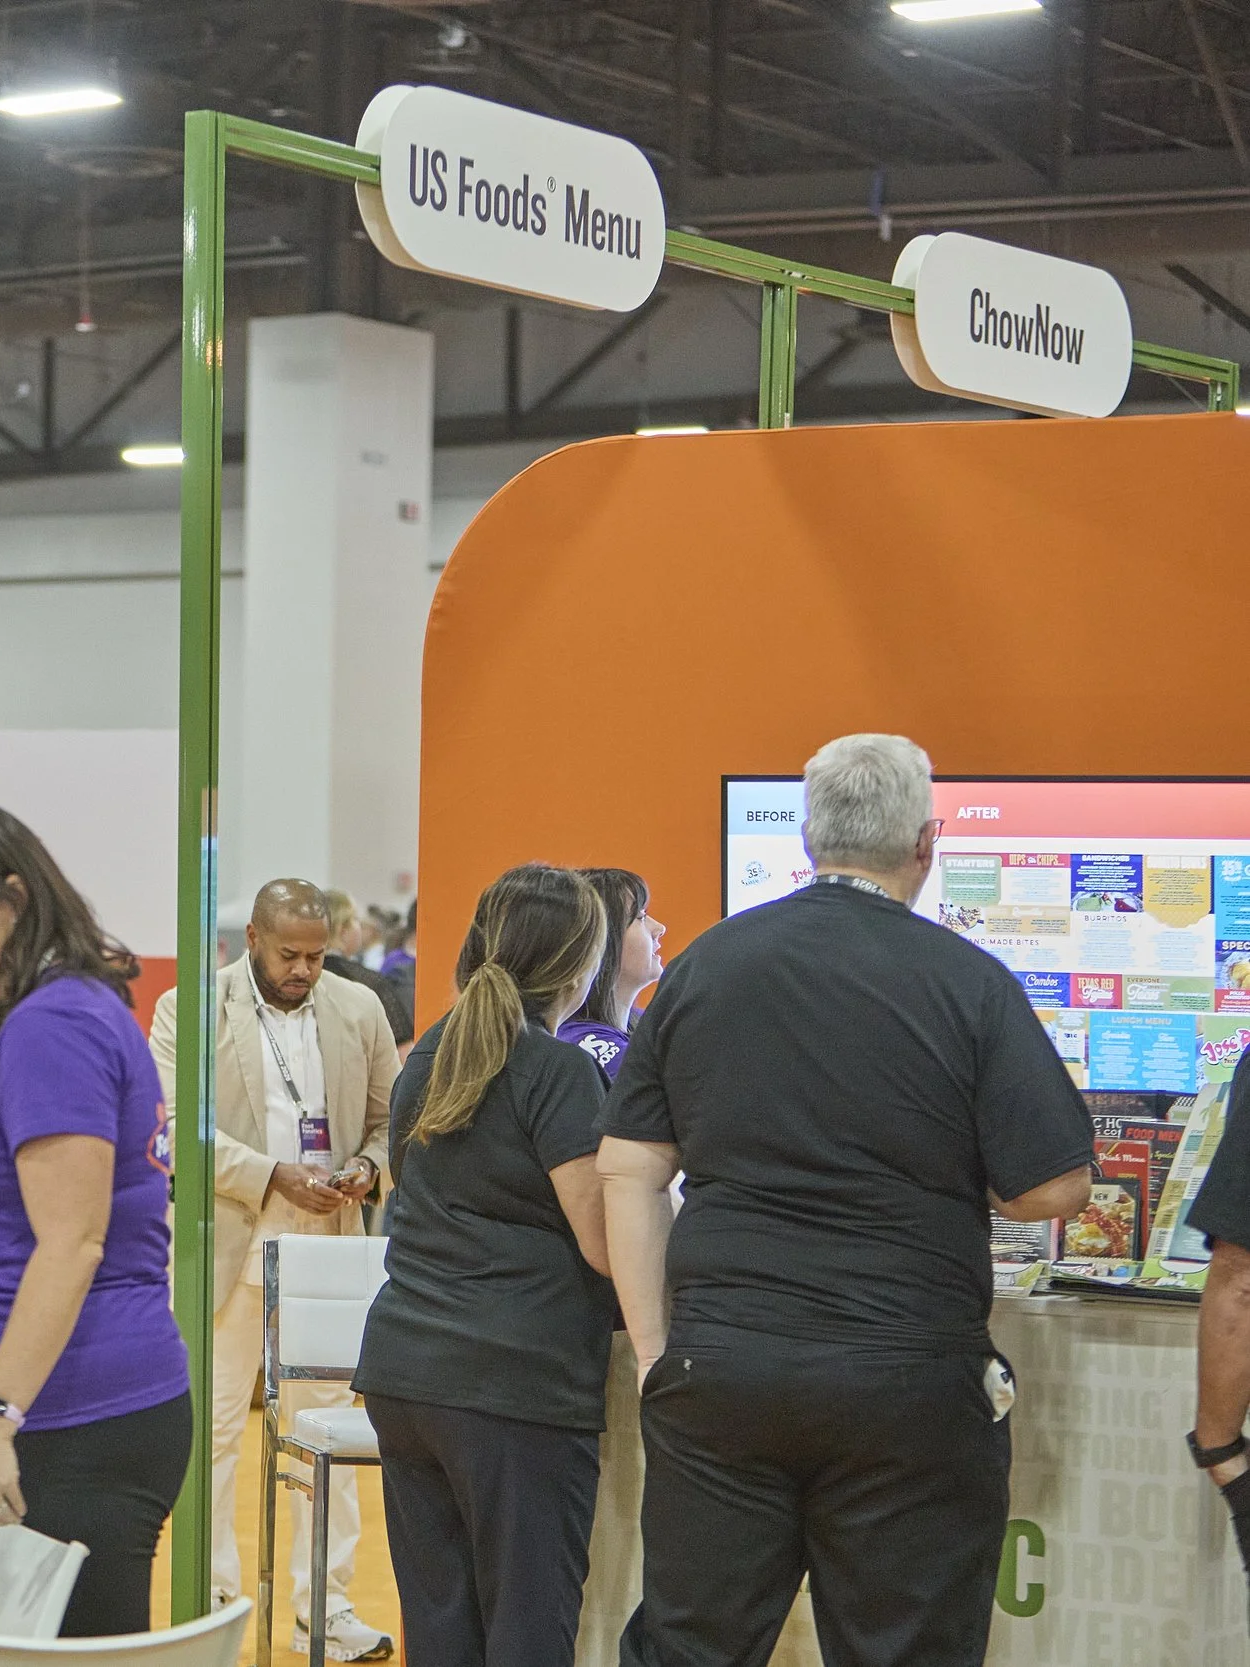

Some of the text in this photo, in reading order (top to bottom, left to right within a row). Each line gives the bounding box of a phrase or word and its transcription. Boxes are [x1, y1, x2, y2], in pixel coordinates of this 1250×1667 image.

[409, 143, 448, 212] US
[564, 184, 642, 260] Menu
[970, 288, 1084, 365] ChowNow
[746, 810, 796, 823] BEFORE
[956, 806, 1000, 819] AFTER
[1084, 914, 1128, 923] BURRITOS
[1016, 938, 1040, 946] BITES
[1025, 973, 1059, 987] Combos
[1125, 1127, 1155, 1140] FOOD
[1158, 1130, 1182, 1142] MEN
[1098, 1153, 1146, 1163] Drink Menu
[1094, 1192, 1109, 1201] NEW
